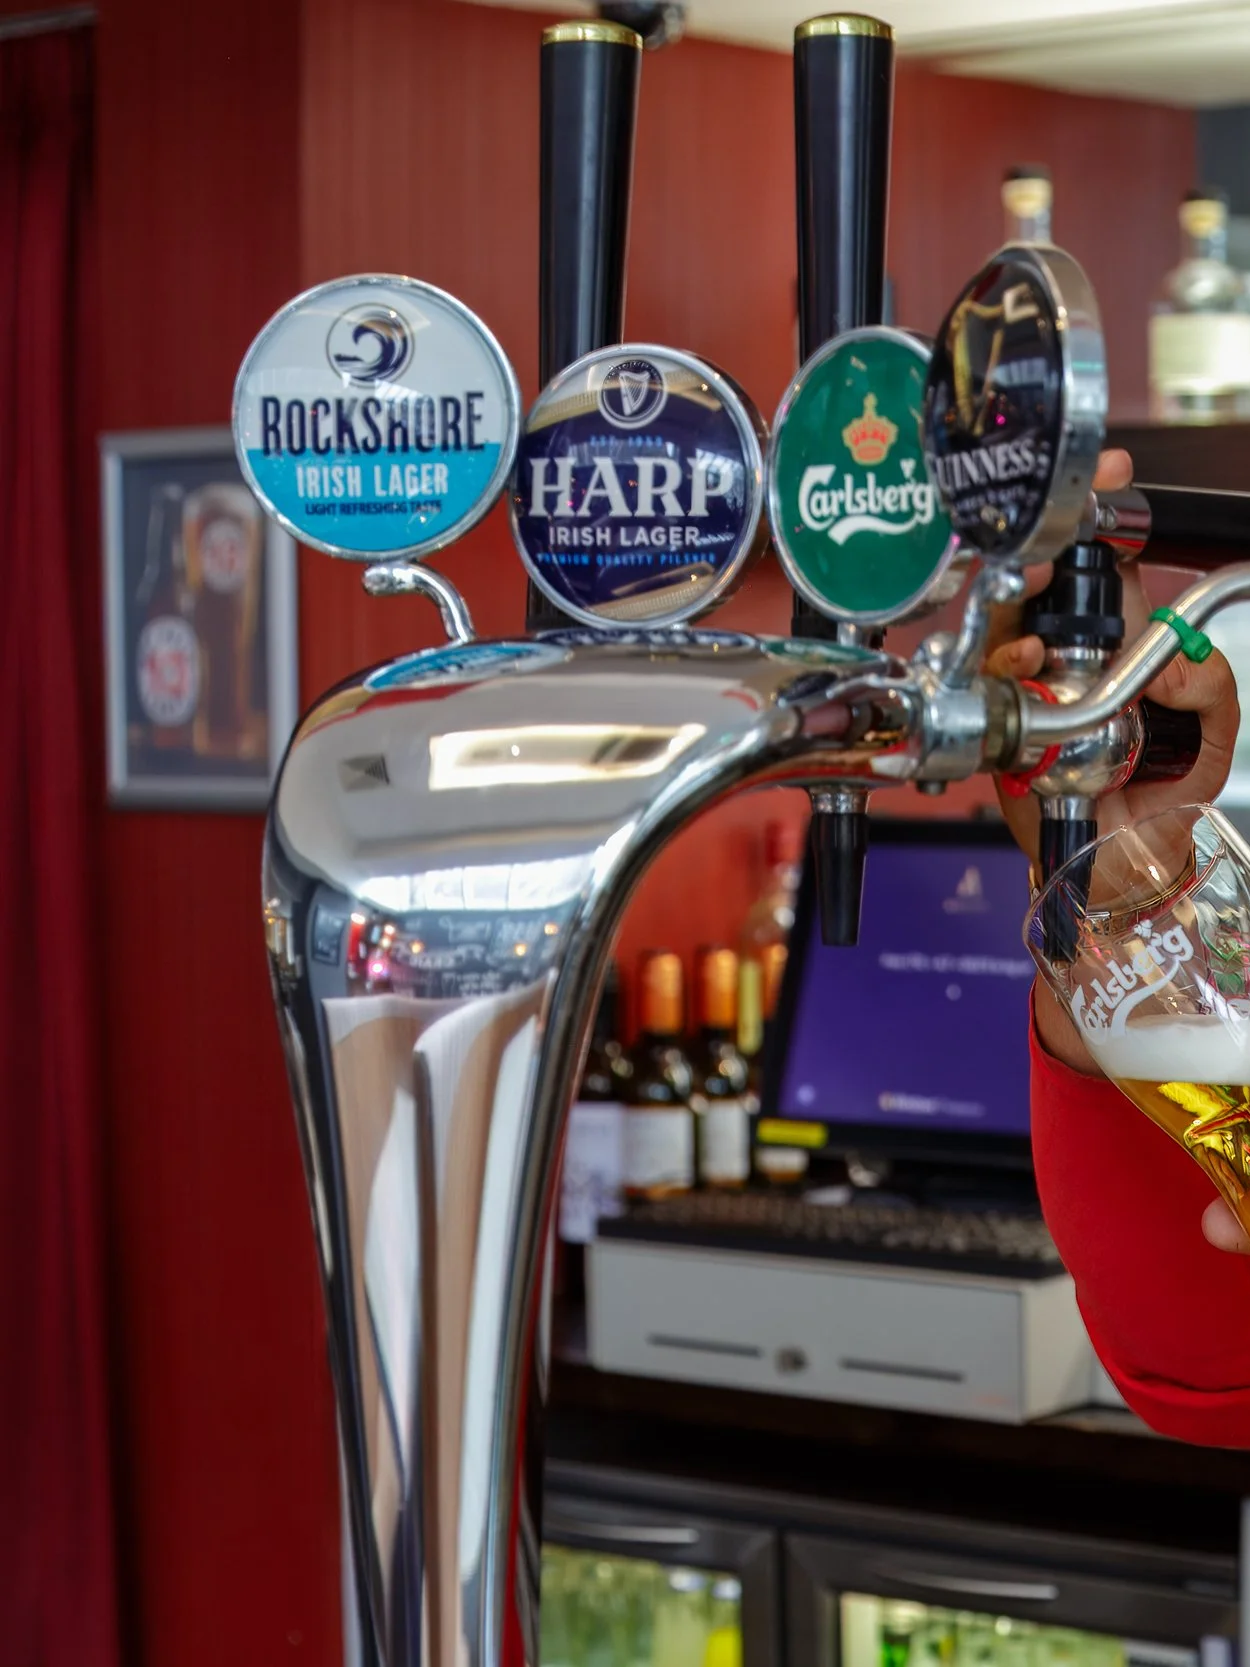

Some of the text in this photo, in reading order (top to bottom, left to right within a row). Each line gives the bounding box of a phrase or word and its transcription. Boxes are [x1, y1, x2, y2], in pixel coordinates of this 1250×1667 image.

[261, 391, 486, 457] ROCKSHORE
[296, 462, 449, 499] IRISH LAGER
[305, 503, 337, 515] LIGHT
[339, 501, 407, 515] REFRESHING
[528, 456, 734, 517] HARP
[798, 458, 935, 533] Carlsberg
[550, 525, 700, 546] IRISH LAGER
[1070, 920, 1195, 1042] Carlsberg
